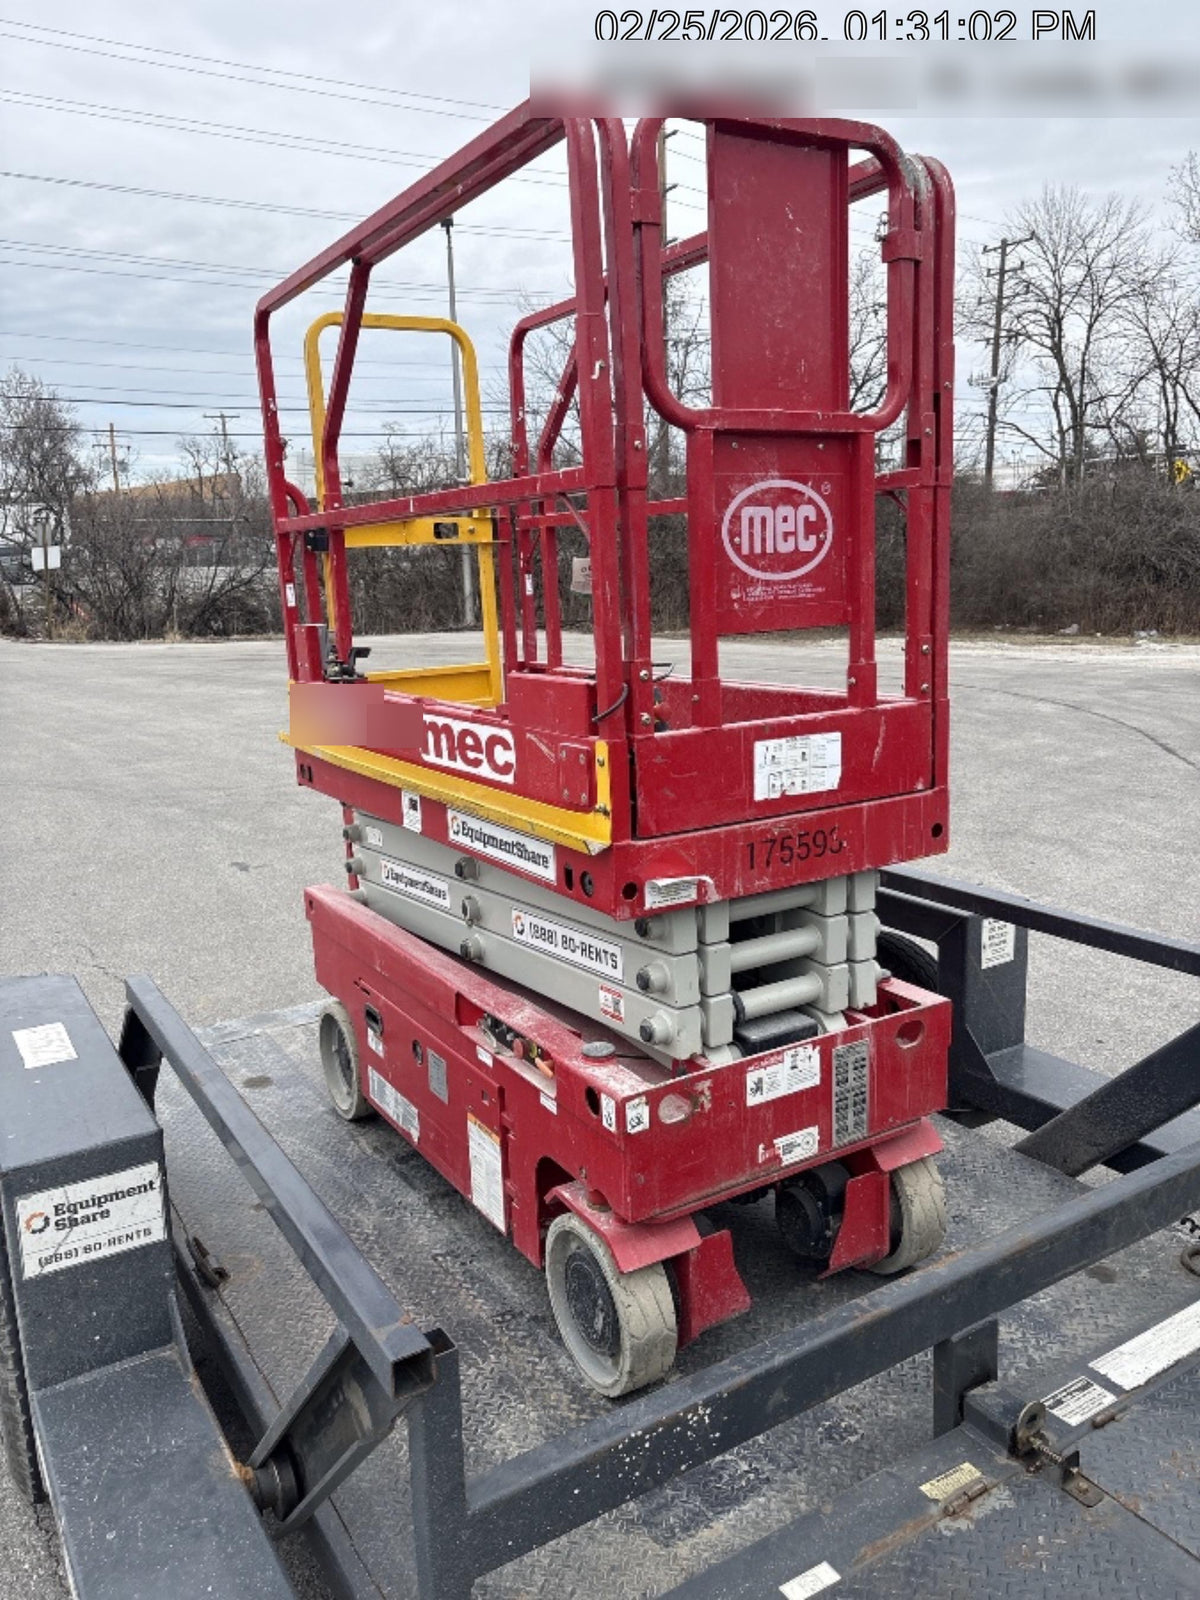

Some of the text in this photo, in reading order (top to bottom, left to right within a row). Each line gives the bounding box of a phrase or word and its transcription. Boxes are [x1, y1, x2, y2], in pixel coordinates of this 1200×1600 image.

[741, 504, 817, 554] mec
[422, 720, 515, 776] mec
[461, 820, 550, 869] EquipmentShare
[528, 921, 618, 970] (888) 80-RENTS
[53, 1179, 157, 1216] Equipment
[54, 1208, 111, 1232] Share
[38, 1227, 153, 1268] (888) 80-RENTS
